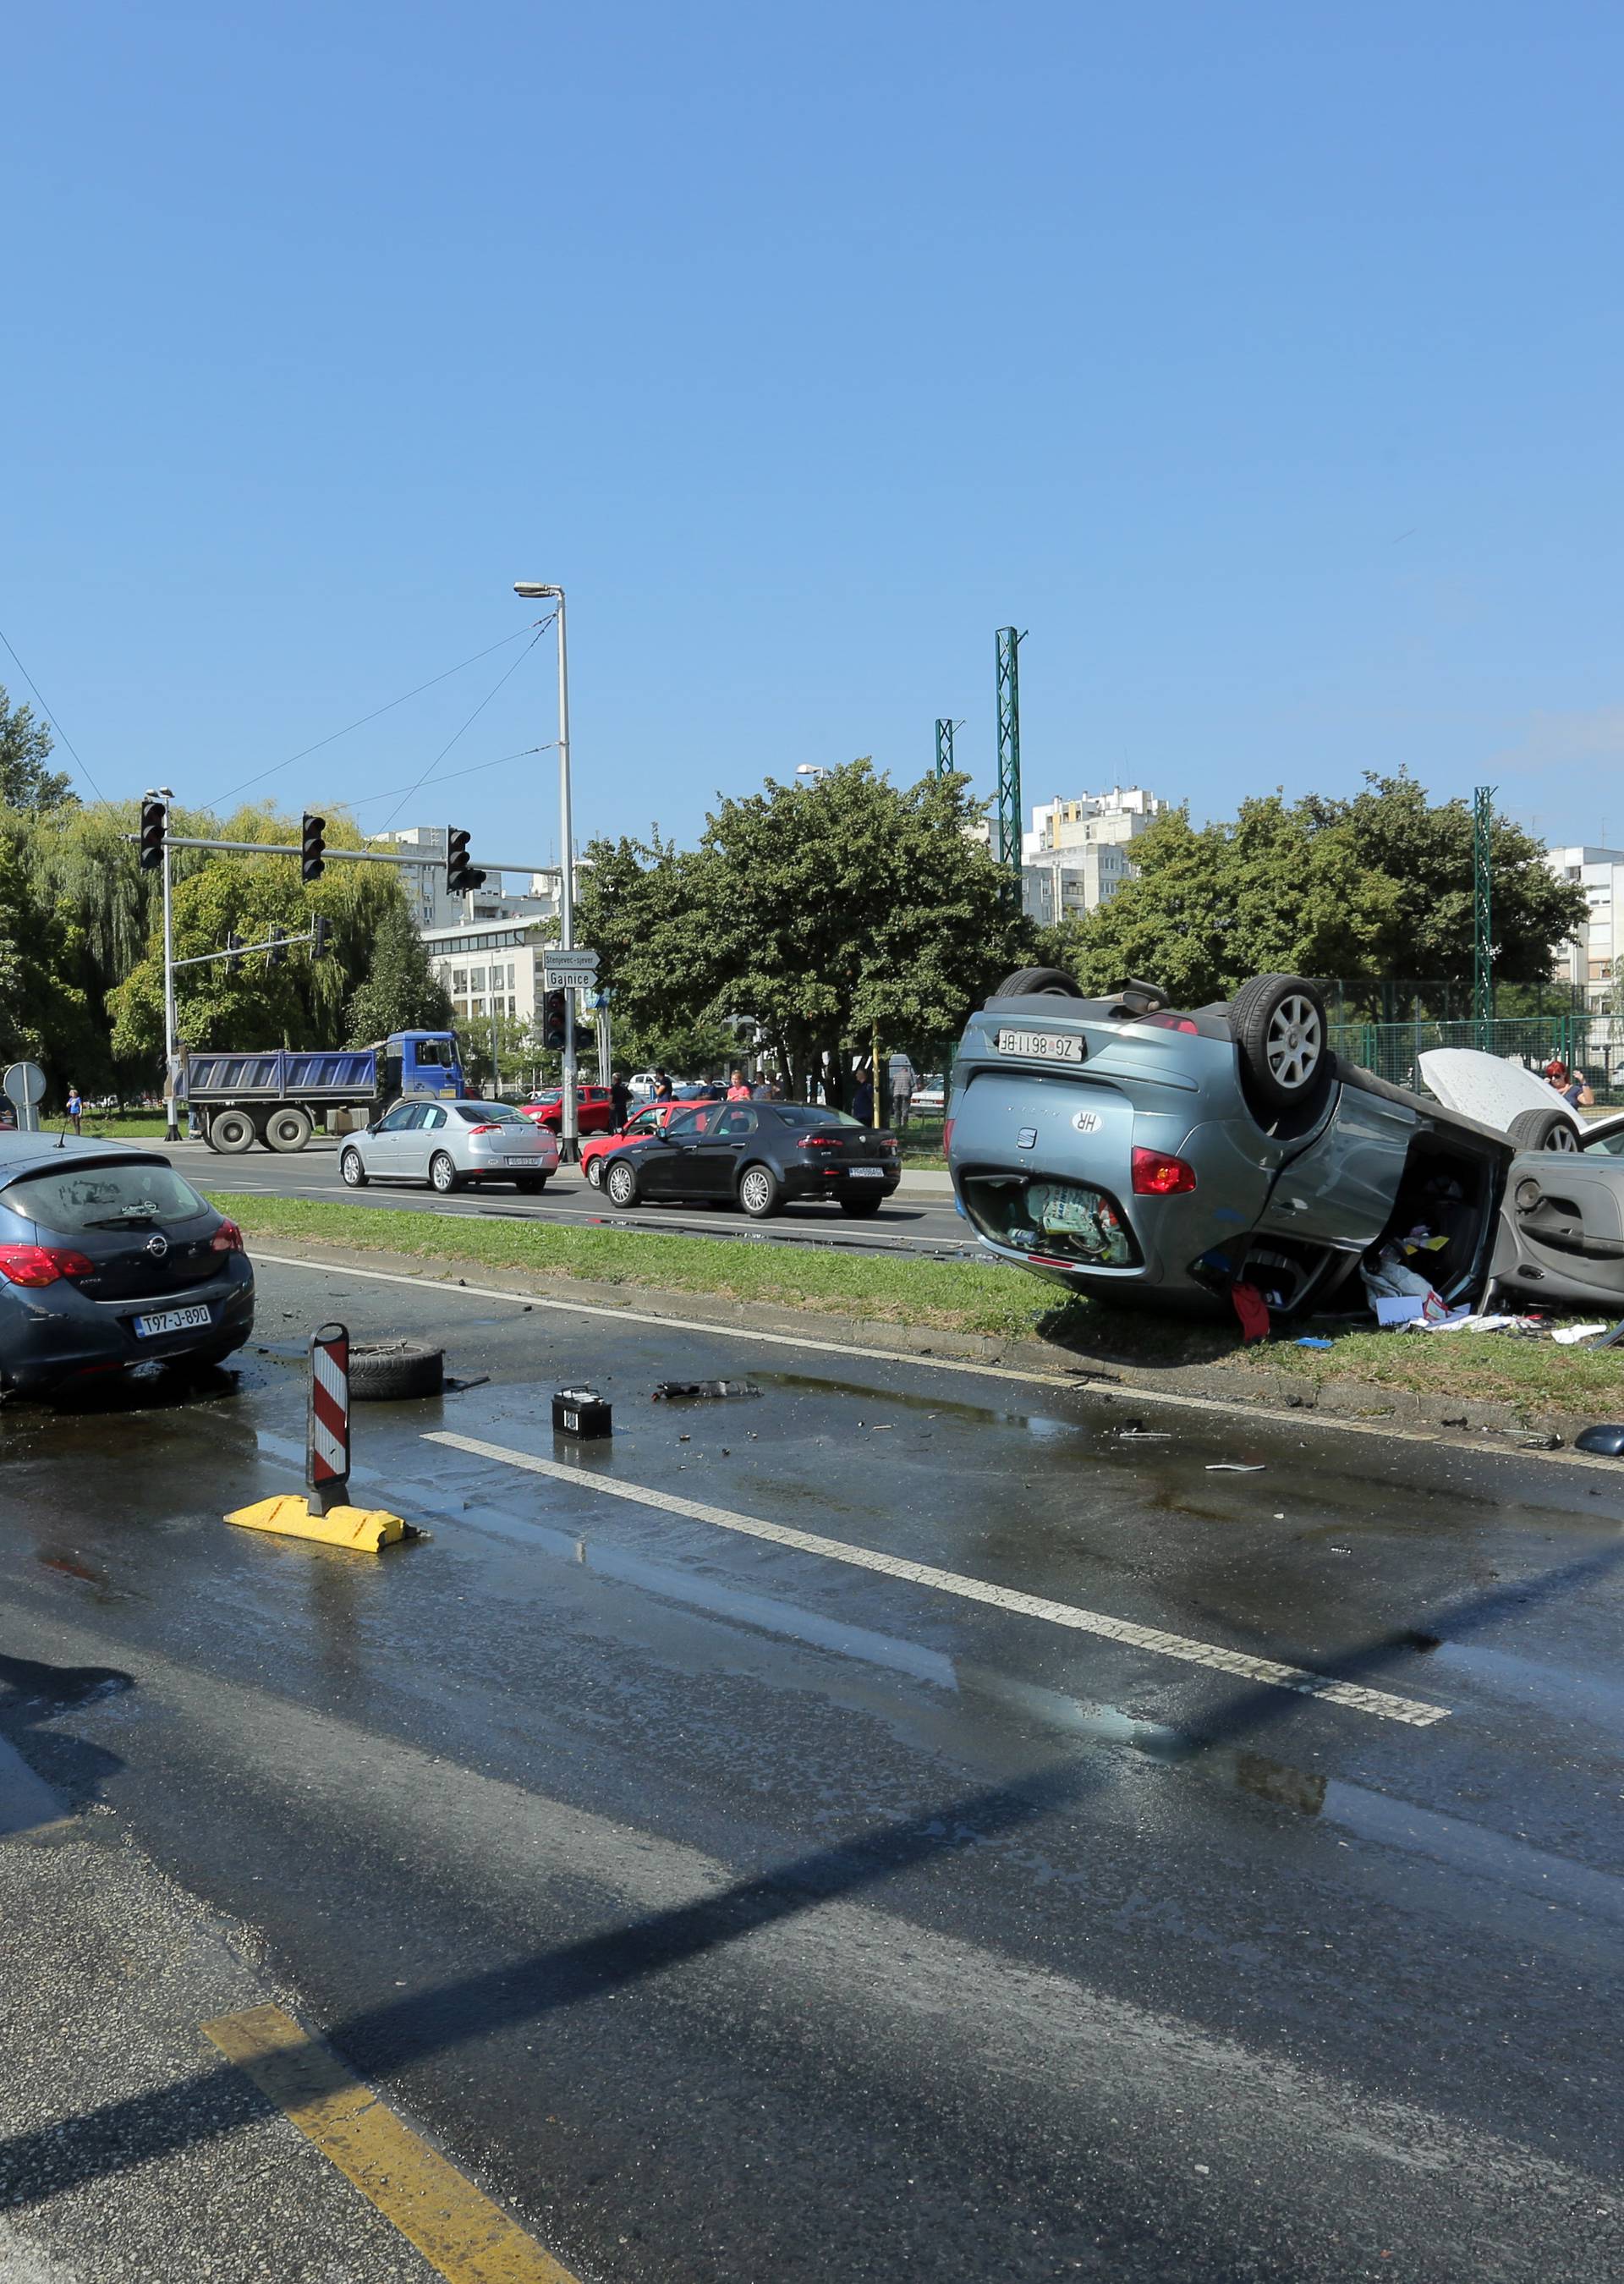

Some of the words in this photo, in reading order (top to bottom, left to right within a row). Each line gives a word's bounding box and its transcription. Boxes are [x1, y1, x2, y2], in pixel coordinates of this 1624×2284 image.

[546, 956, 593, 965] Stenjevec-sjever
[551, 972, 589, 987] Gajnice
[1056, 1040, 1072, 1057] ZG
[1078, 1112, 1097, 1131] HR
